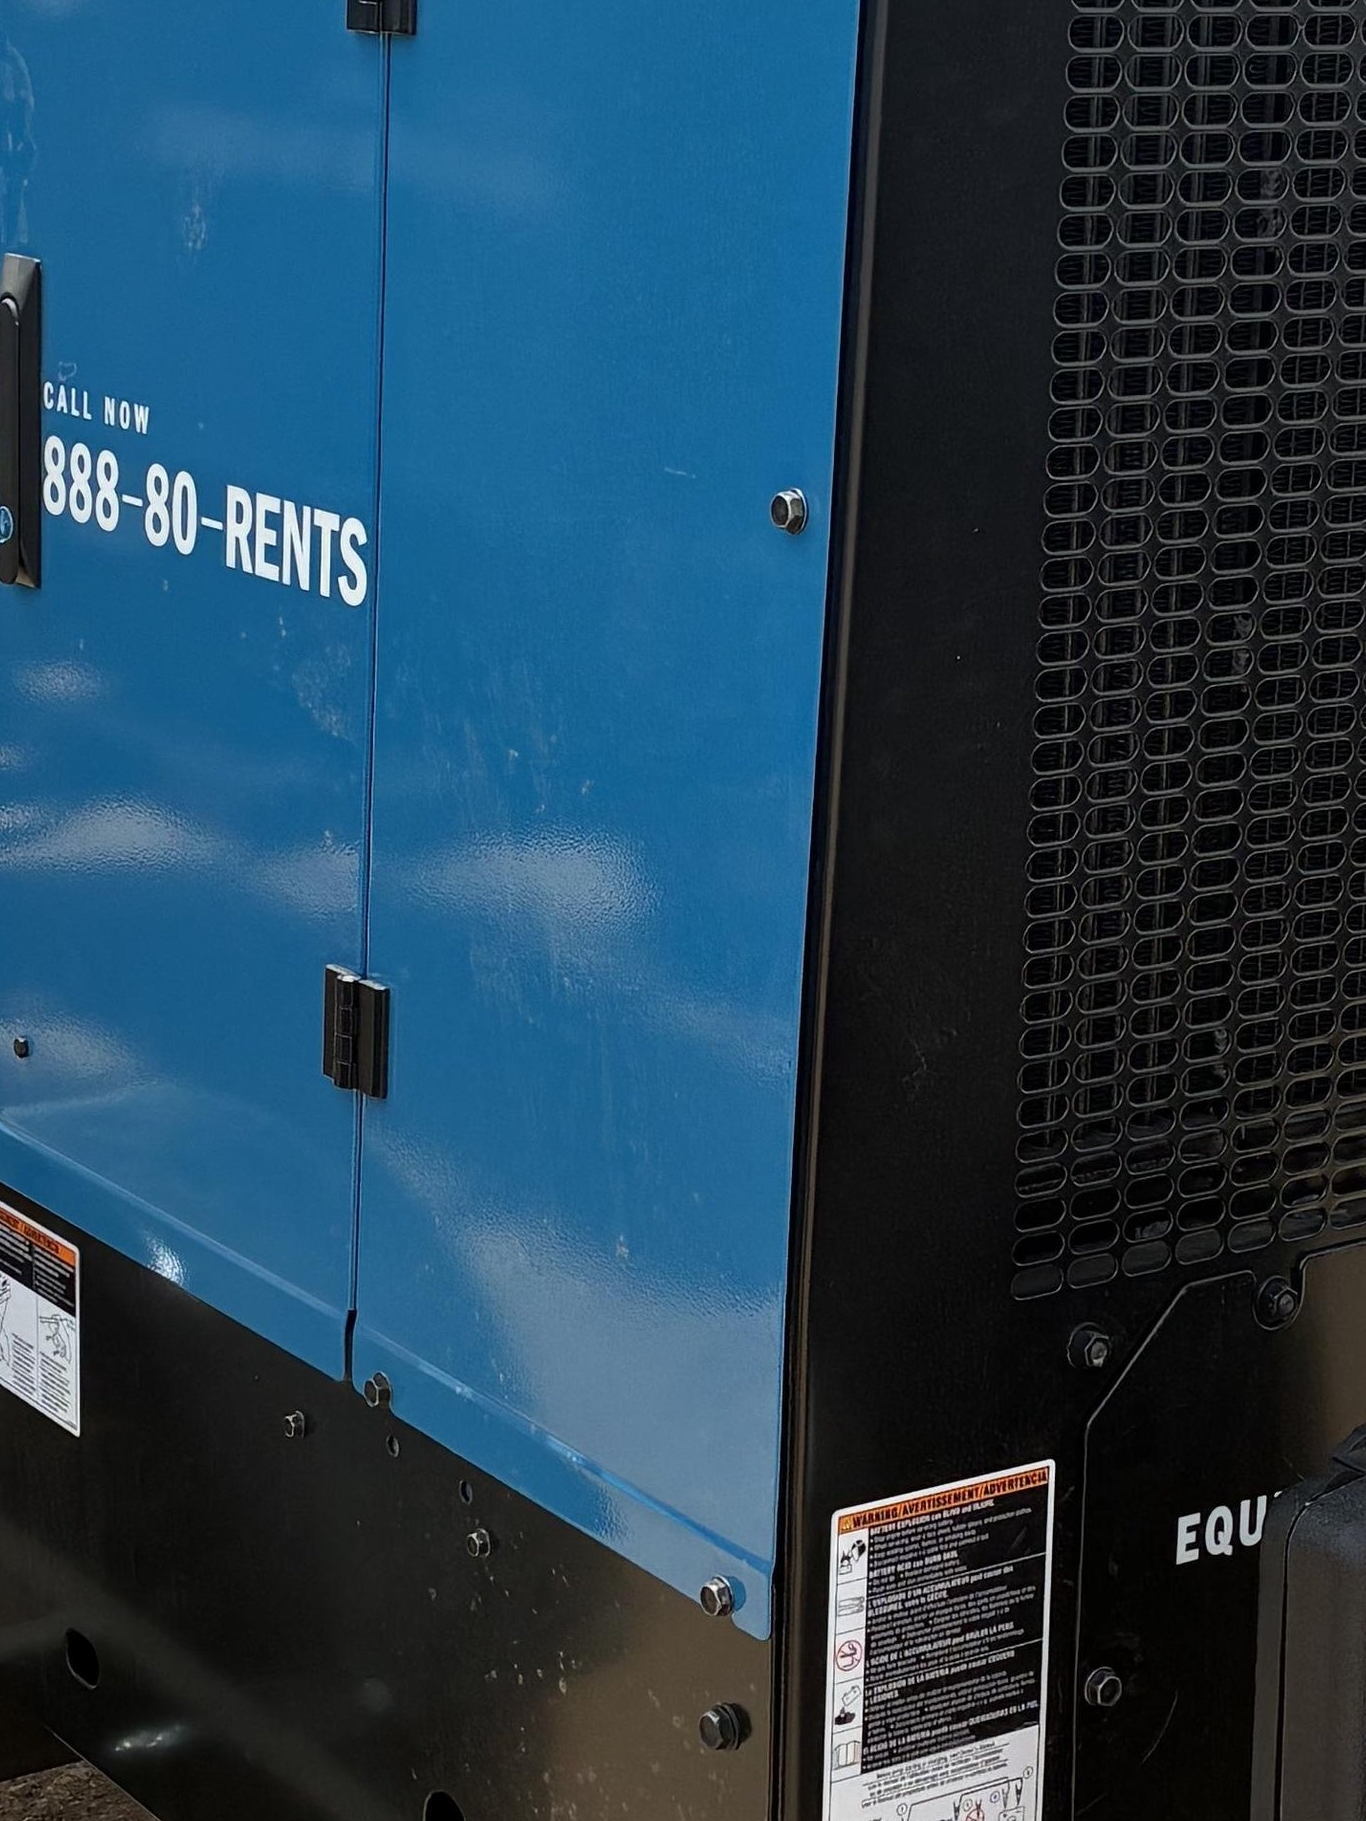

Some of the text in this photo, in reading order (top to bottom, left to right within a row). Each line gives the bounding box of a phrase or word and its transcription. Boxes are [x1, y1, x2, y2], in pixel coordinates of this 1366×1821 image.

[43, 381, 150, 435] CALL NOW
[42, 434, 368, 607] 888-80-RENTS
[1176, 1491, 1275, 1565] EQU
